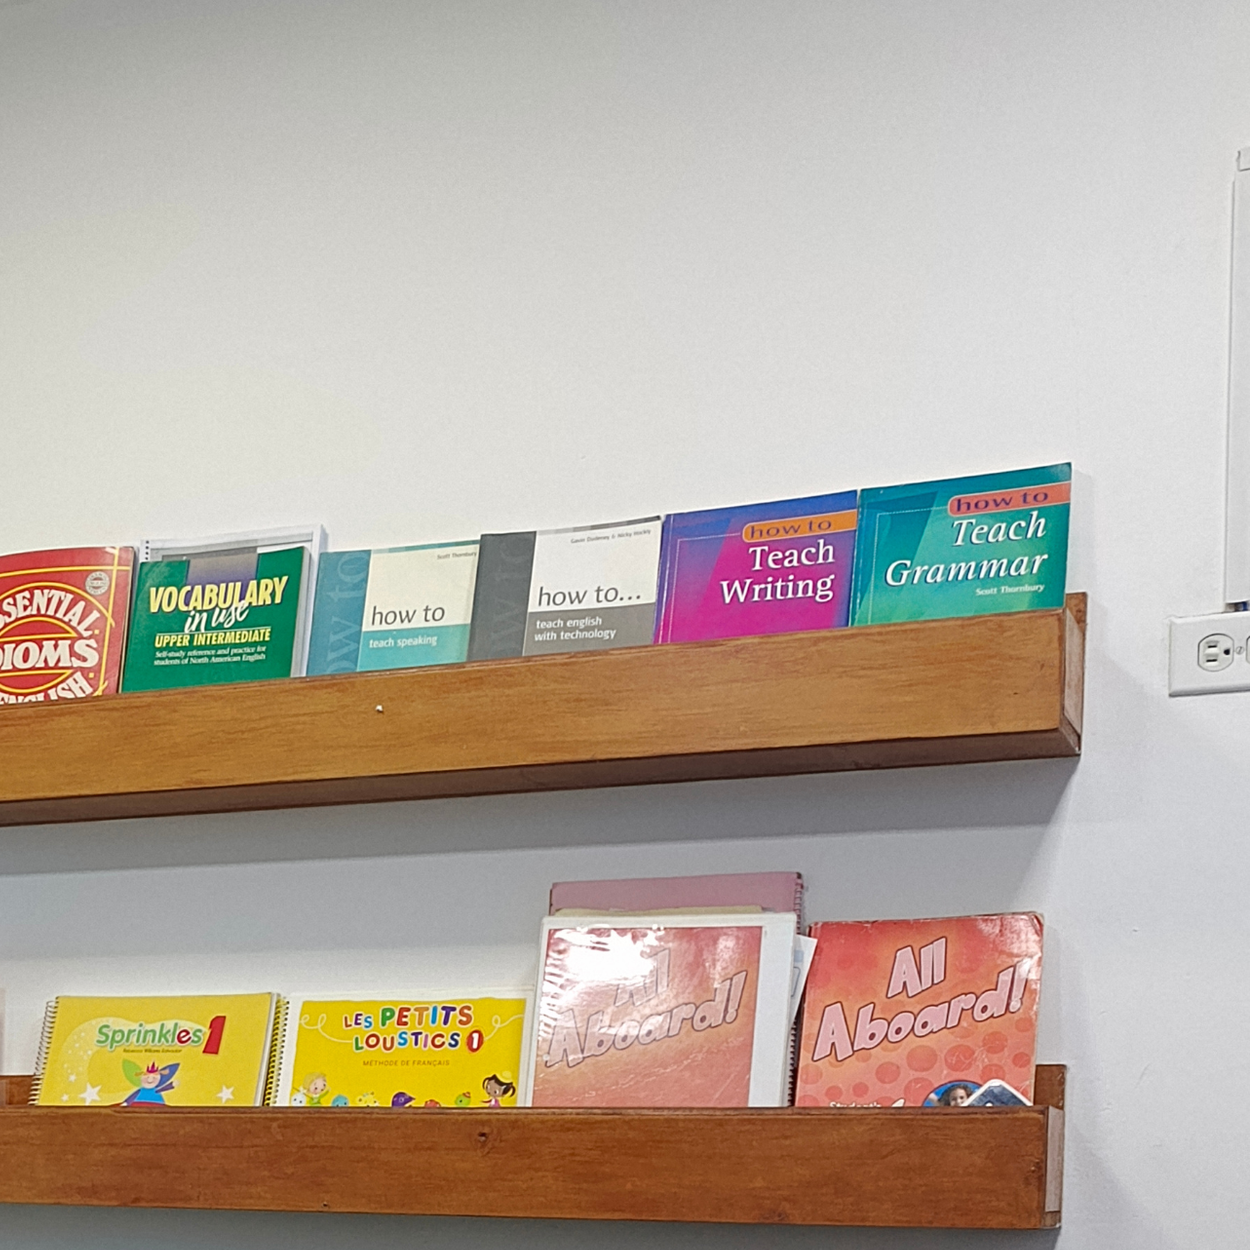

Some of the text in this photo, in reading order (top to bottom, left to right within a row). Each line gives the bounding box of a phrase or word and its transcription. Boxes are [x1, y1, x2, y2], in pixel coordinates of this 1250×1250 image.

[956, 492, 1049, 512] how to
[750, 520, 832, 539] how to
[952, 510, 1047, 547] Teach
[748, 538, 836, 571] Teach
[884, 553, 1049, 587] Grammar
[149, 575, 289, 613] VOCABULARY
[538, 585, 642, 607] how to...
[719, 574, 836, 605] Writing
[975, 584, 1046, 596] Scott Thornbury
[184, 599, 250, 633] in use
[371, 605, 446, 626] how to
[536, 616, 603, 630] teach english
[154, 628, 272, 648] UPPER INTERMEDIATE
[369, 635, 438, 649] teach speaking
[534, 629, 617, 642] with technology
[216, 647, 230, 655] and
[886, 936, 948, 998] All
[344, 1004, 473, 1029] LES PETITS
[545, 970, 748, 1068] Aboard!
[812, 957, 1032, 1062] Aboard!
[95, 1015, 227, 1055] Sprinkles 1
[354, 1030, 461, 1051] LOUSTICS
[412, 1059, 450, 1068] FRANÇAIS
